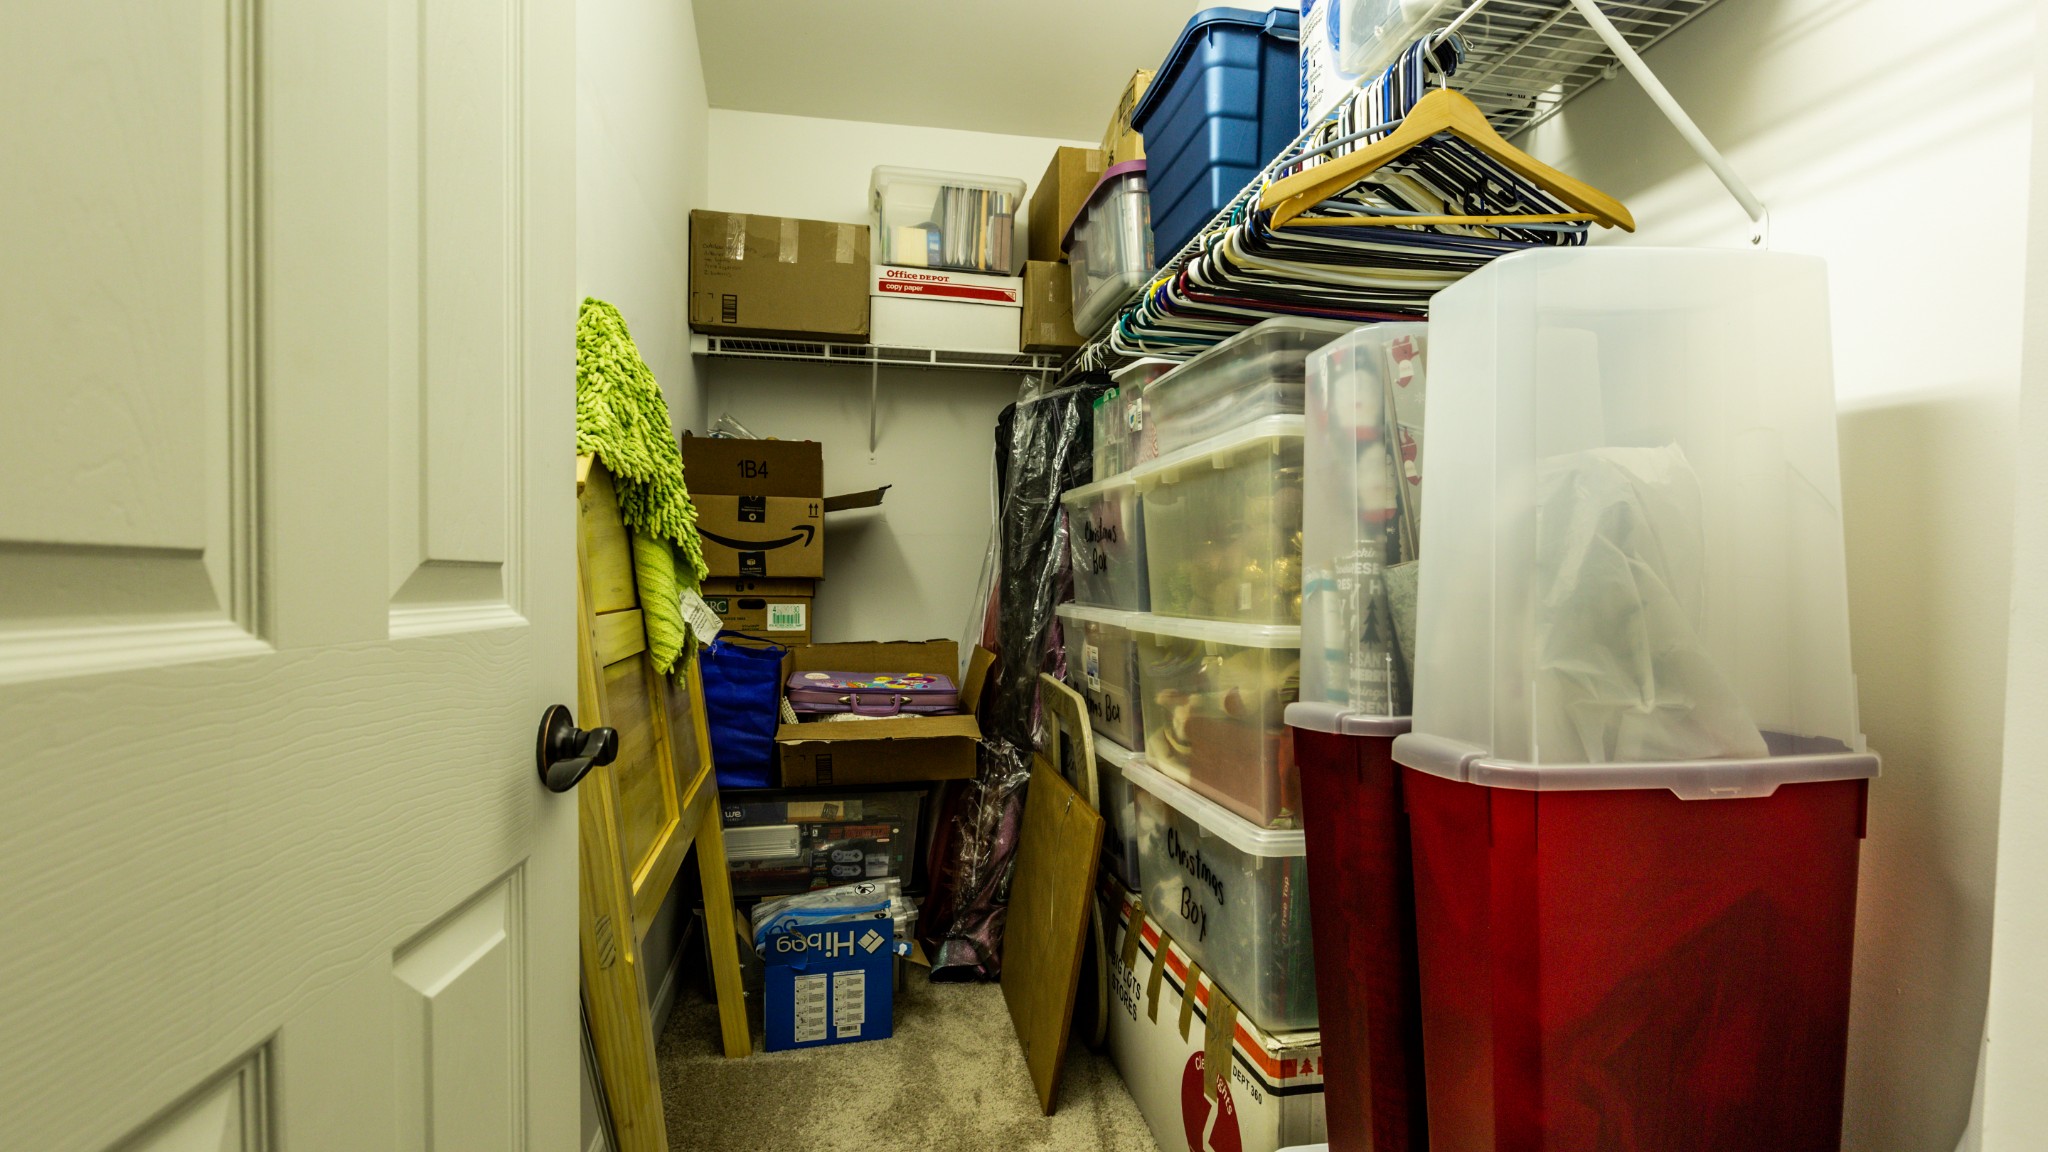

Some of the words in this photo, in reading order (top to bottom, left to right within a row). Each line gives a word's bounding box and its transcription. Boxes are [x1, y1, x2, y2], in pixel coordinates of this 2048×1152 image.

[886, 269, 918, 280] Office
[886, 283, 903, 291] copy
[903, 284, 924, 292] paper
[737, 459, 769, 479] 1B4
[1085, 517, 1117, 543] Christmas
[1093, 548, 1107, 575] Box
[707, 600, 727, 613] RC
[1105, 694, 1121, 723] Box
[1168, 827, 1224, 905] Christmas
[1281, 902, 1289, 928] Tree
[1111, 953, 1123, 974] BIG
[1123, 967, 1142, 1001] LOTS
[1111, 974, 1137, 1022] STORES
[1194, 1055, 1205, 1070] Cle
[1216, 1073, 1233, 1115] ights
[1232, 1065, 1250, 1091] DEPT
[1251, 1084, 1263, 1105] 360
